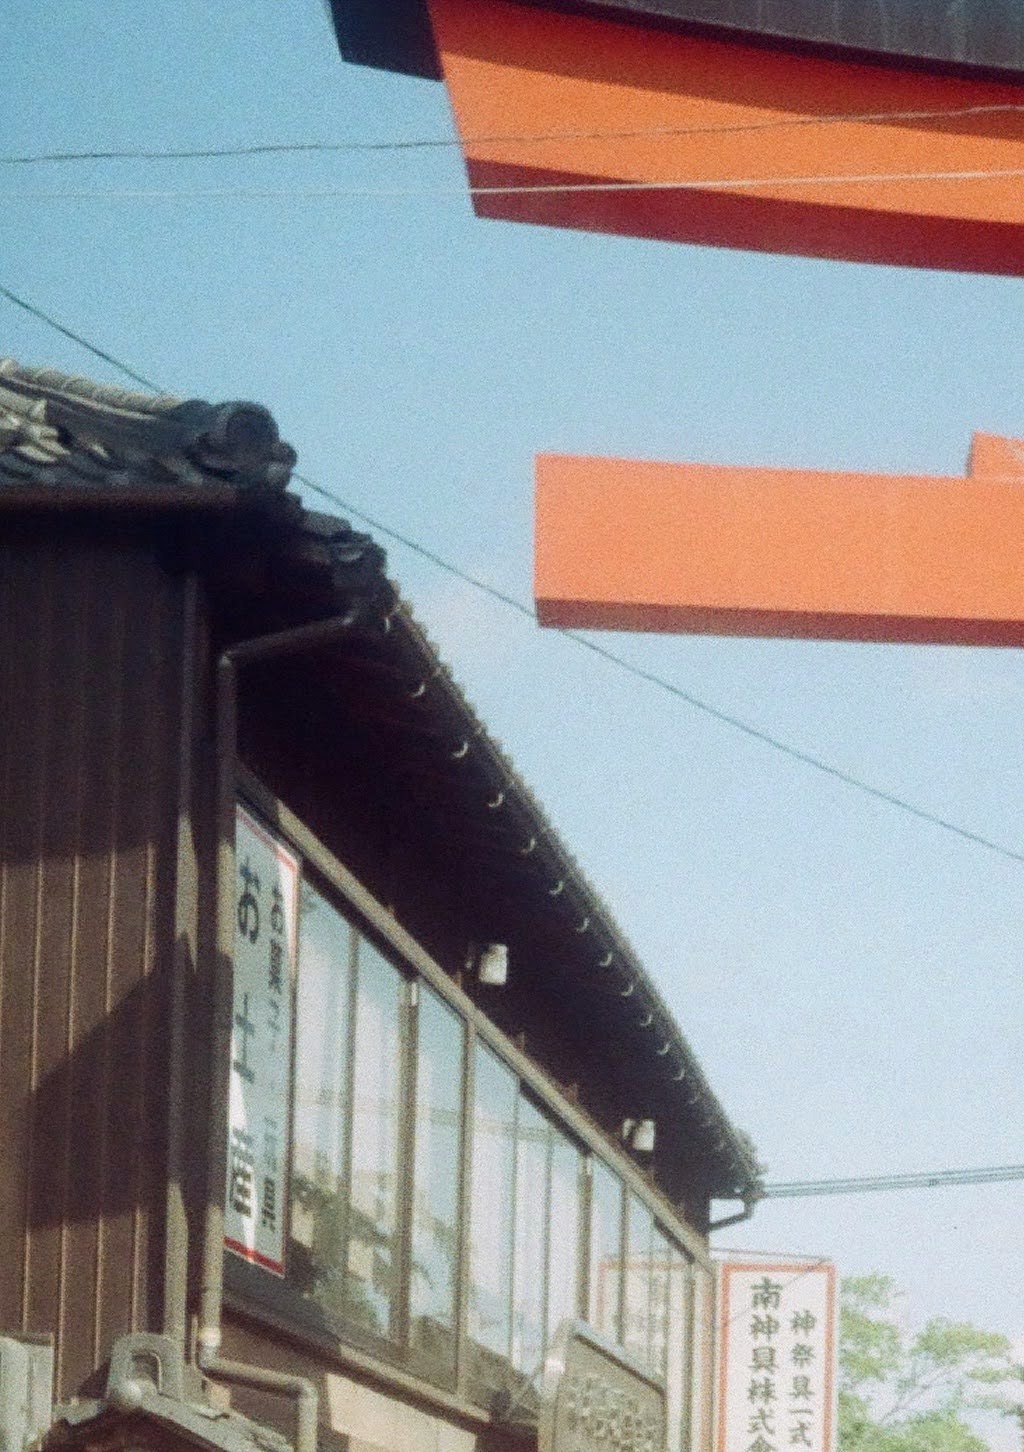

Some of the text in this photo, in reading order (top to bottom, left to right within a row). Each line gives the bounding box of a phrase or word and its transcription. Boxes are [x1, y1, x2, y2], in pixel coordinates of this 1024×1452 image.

[789, 1308, 817, 1448] 神祭具一式
